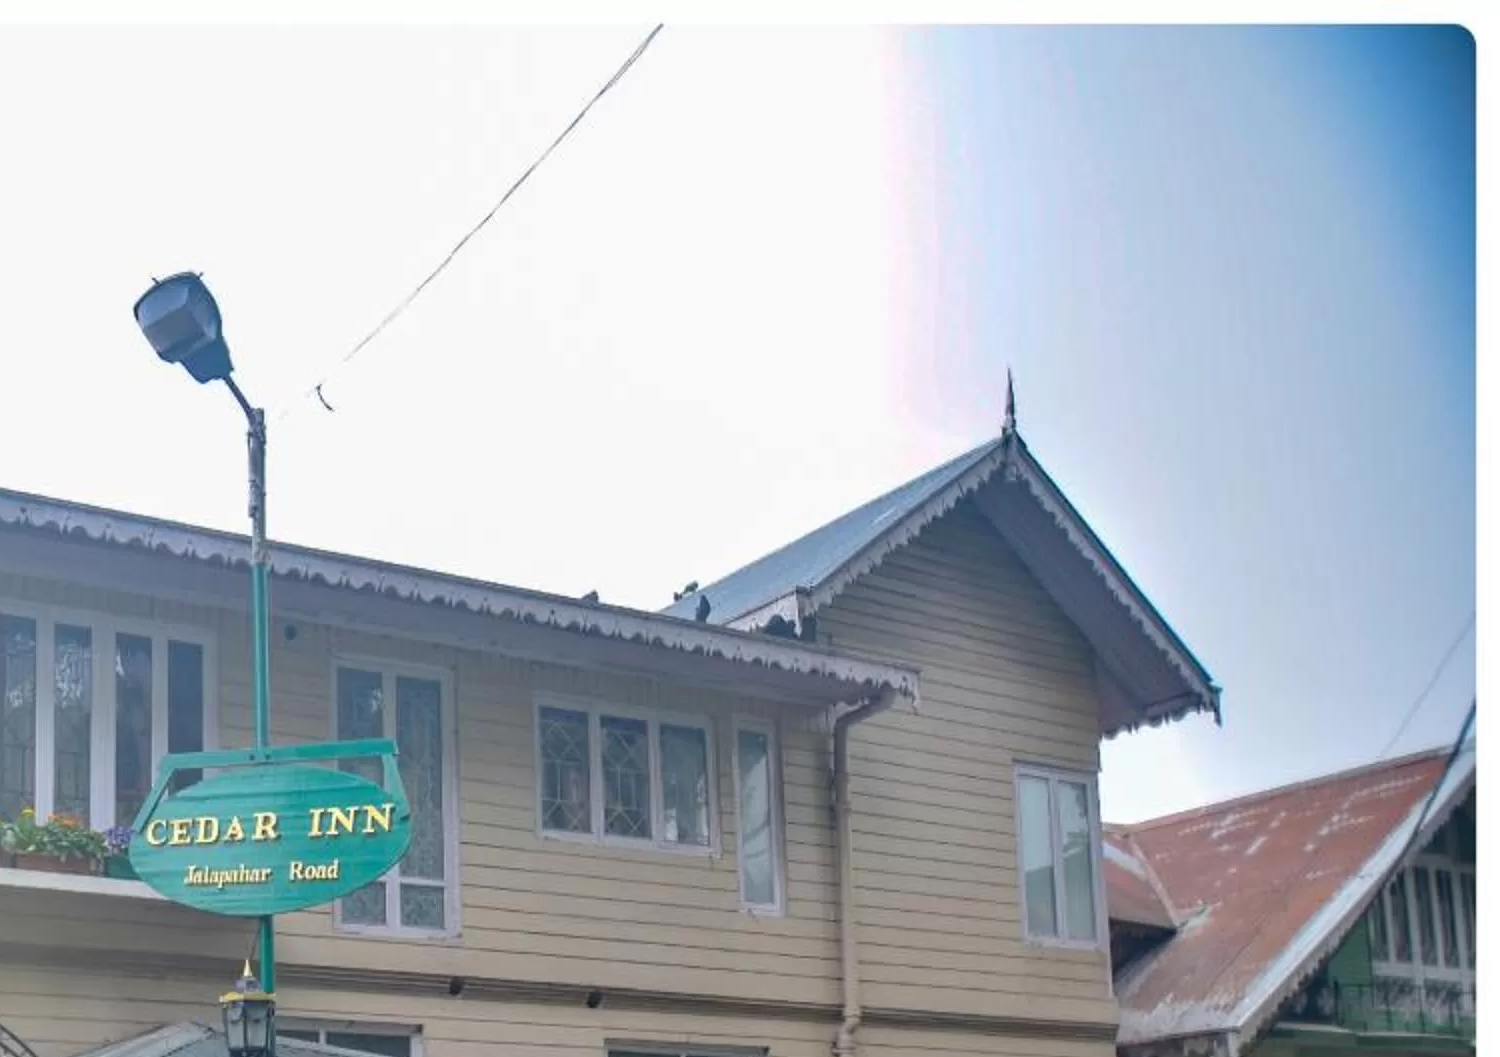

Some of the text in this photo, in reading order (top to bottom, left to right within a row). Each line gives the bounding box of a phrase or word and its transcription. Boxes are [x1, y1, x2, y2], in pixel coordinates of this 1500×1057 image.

[146, 803, 395, 845] CEDAR INN
[184, 858, 340, 891] Jalapahar Road
